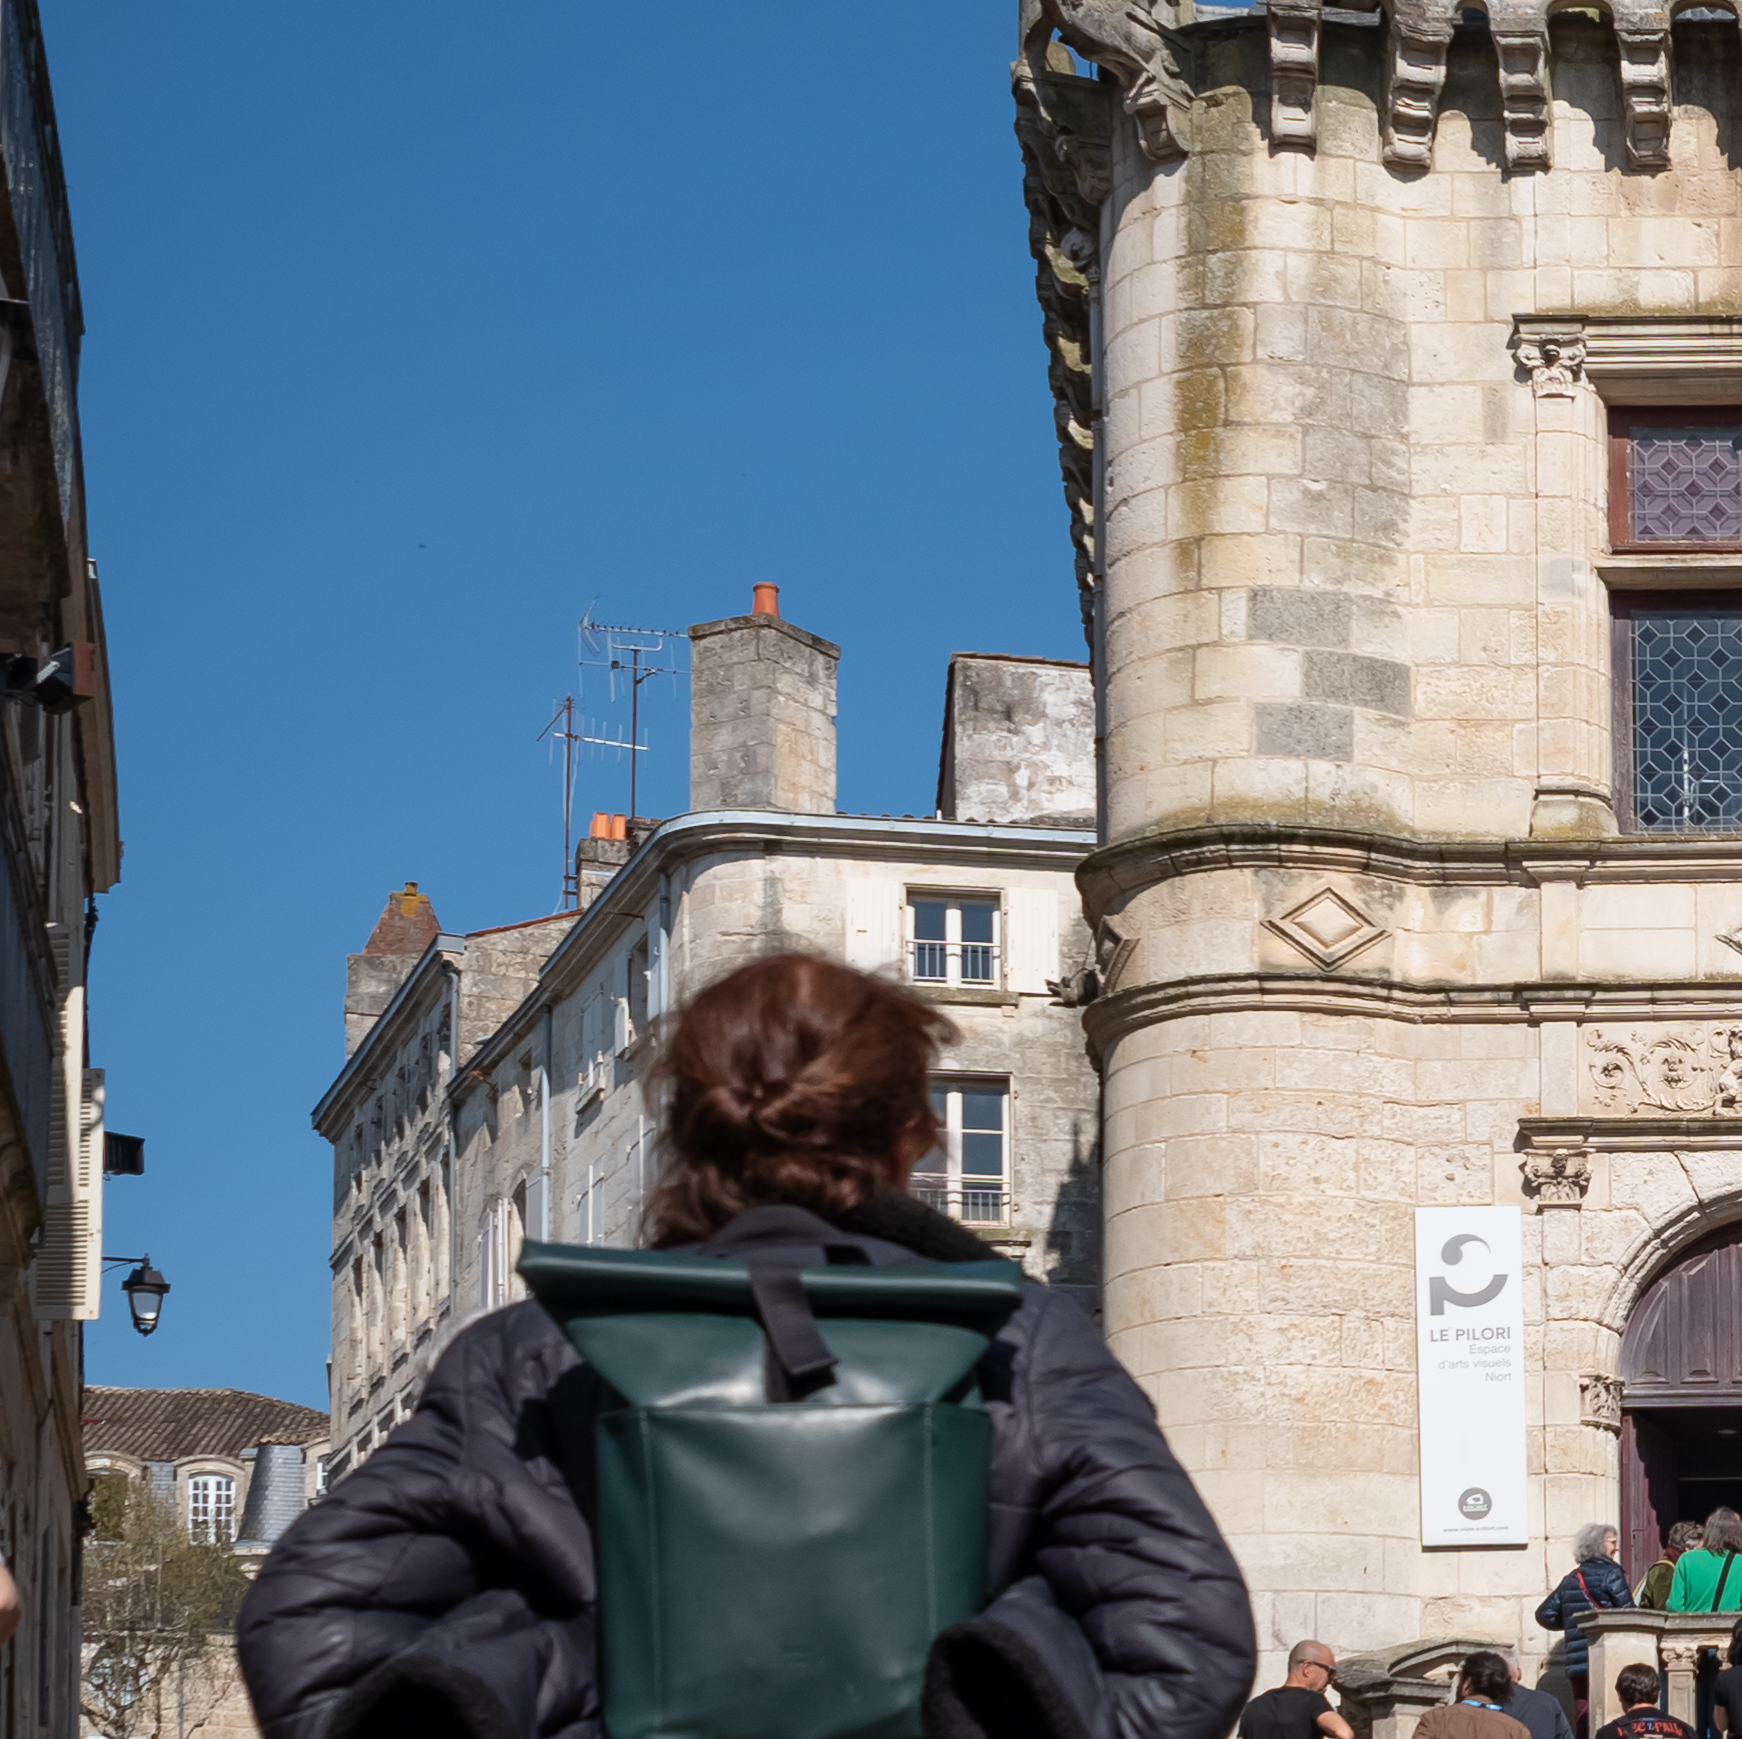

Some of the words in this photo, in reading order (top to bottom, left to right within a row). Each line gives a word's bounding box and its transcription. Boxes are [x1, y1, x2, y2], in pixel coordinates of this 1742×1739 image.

[1430, 1328, 1449, 1342] LE
[1455, 1326, 1511, 1341] PILORI
[1469, 1344, 1511, 1355] Espace
[1473, 1357, 1512, 1368] visuels
[1485, 1372, 1512, 1382] Niort
